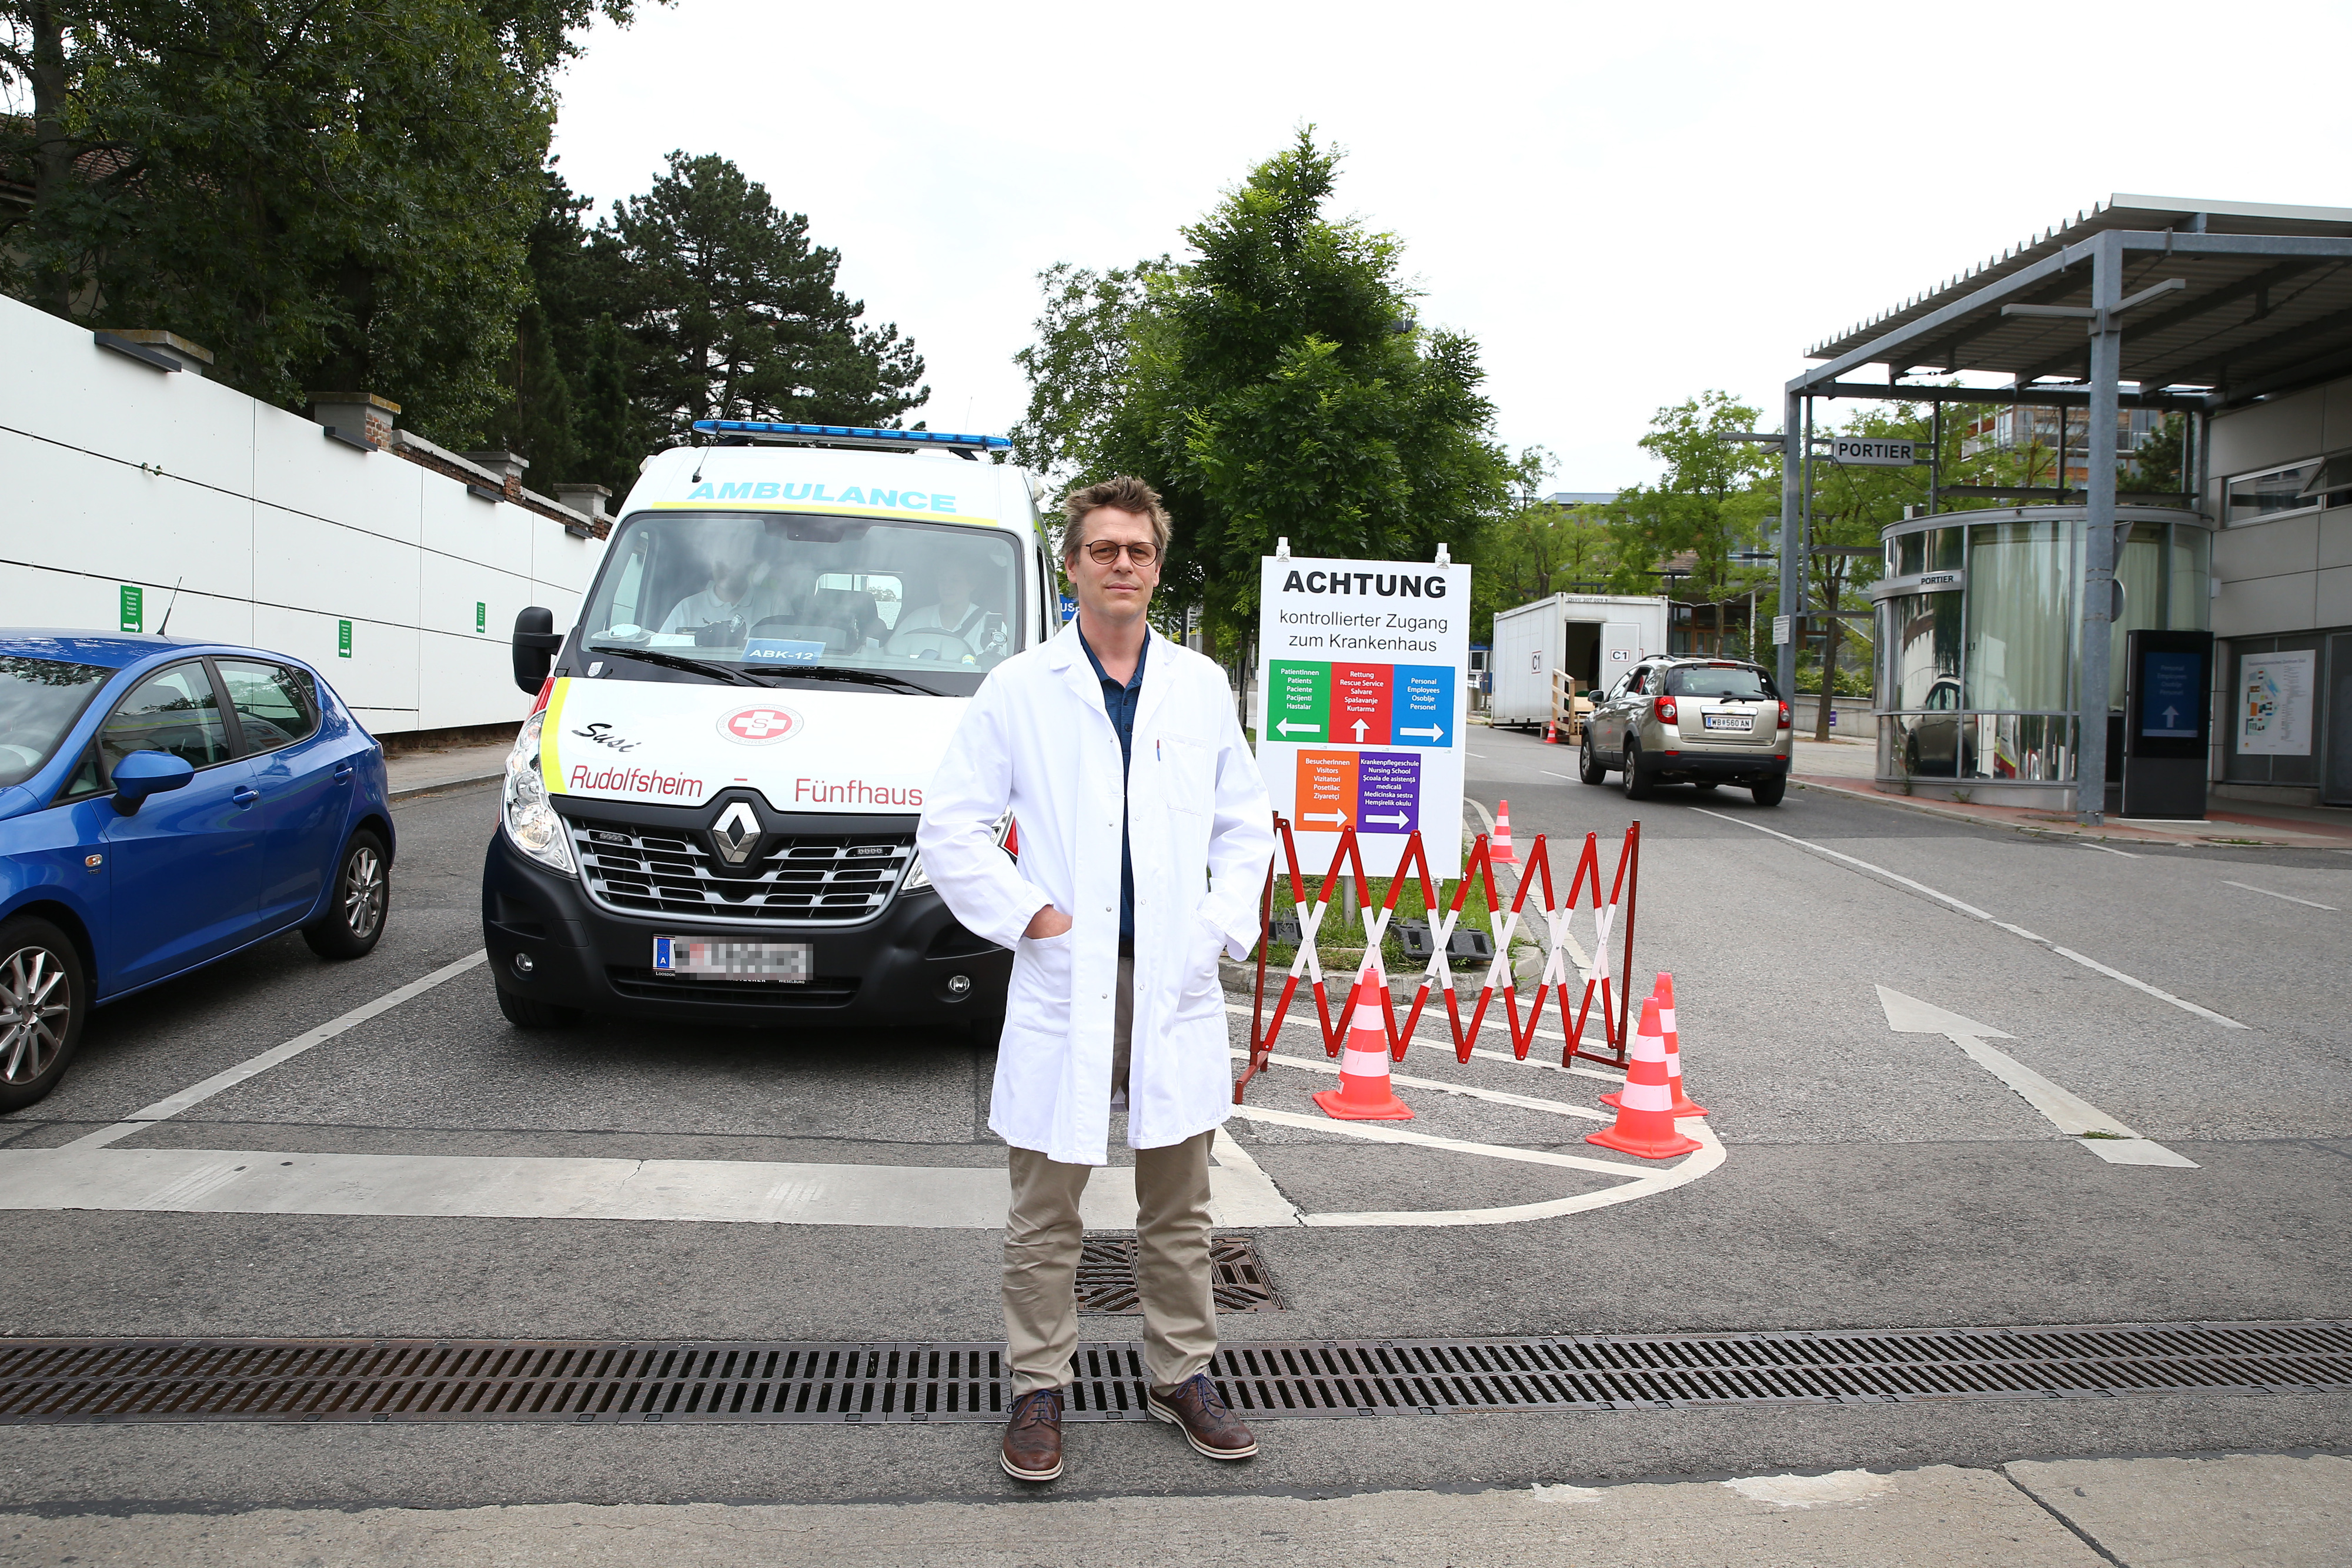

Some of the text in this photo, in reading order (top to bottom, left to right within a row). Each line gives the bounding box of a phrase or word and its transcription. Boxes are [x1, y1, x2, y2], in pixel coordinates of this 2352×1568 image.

[1839, 443, 1911, 459] PORTIER
[687, 482, 957, 513] AMBULANCE
[1282, 570, 1446, 599] ACHTUNG
[1921, 576, 1953, 584] PORTIER
[1279, 609, 1448, 633] kontrollierter Zugang
[1289, 634, 1437, 651] zum Krankenhaus
[749, 650, 814, 660] ABK-12
[1612, 651, 1628, 660] C1
[1532, 655, 1540, 670] C1
[1281, 668, 1319, 676] PatientInnen
[1350, 671, 1374, 680] Rettung
[1407, 686, 1440, 694] Employees
[1286, 694, 1312, 703] Pacijenti
[1344, 697, 1378, 706] Spašavanje
[1411, 694, 1435, 703] Osoblje
[719, 705, 801, 733] ARBEITER SAMARITER BUND
[751, 718, 769, 728] S
[1726, 718, 1739, 727] 560
[572, 723, 642, 752] Susi
[724, 732, 786, 744] ÖSTERREICHS
[1360, 758, 1420, 767] Krankenpflegeschule
[1368, 767, 1391, 775] Nursing
[1362, 774, 1381, 783] Şcoala
[570, 765, 703, 797] Rudolfsheim
[796, 778, 923, 806] Fünfhaus
[1313, 793, 1340, 801] Ziyaretçi
[1365, 799, 1395, 807] Hemşirelik
